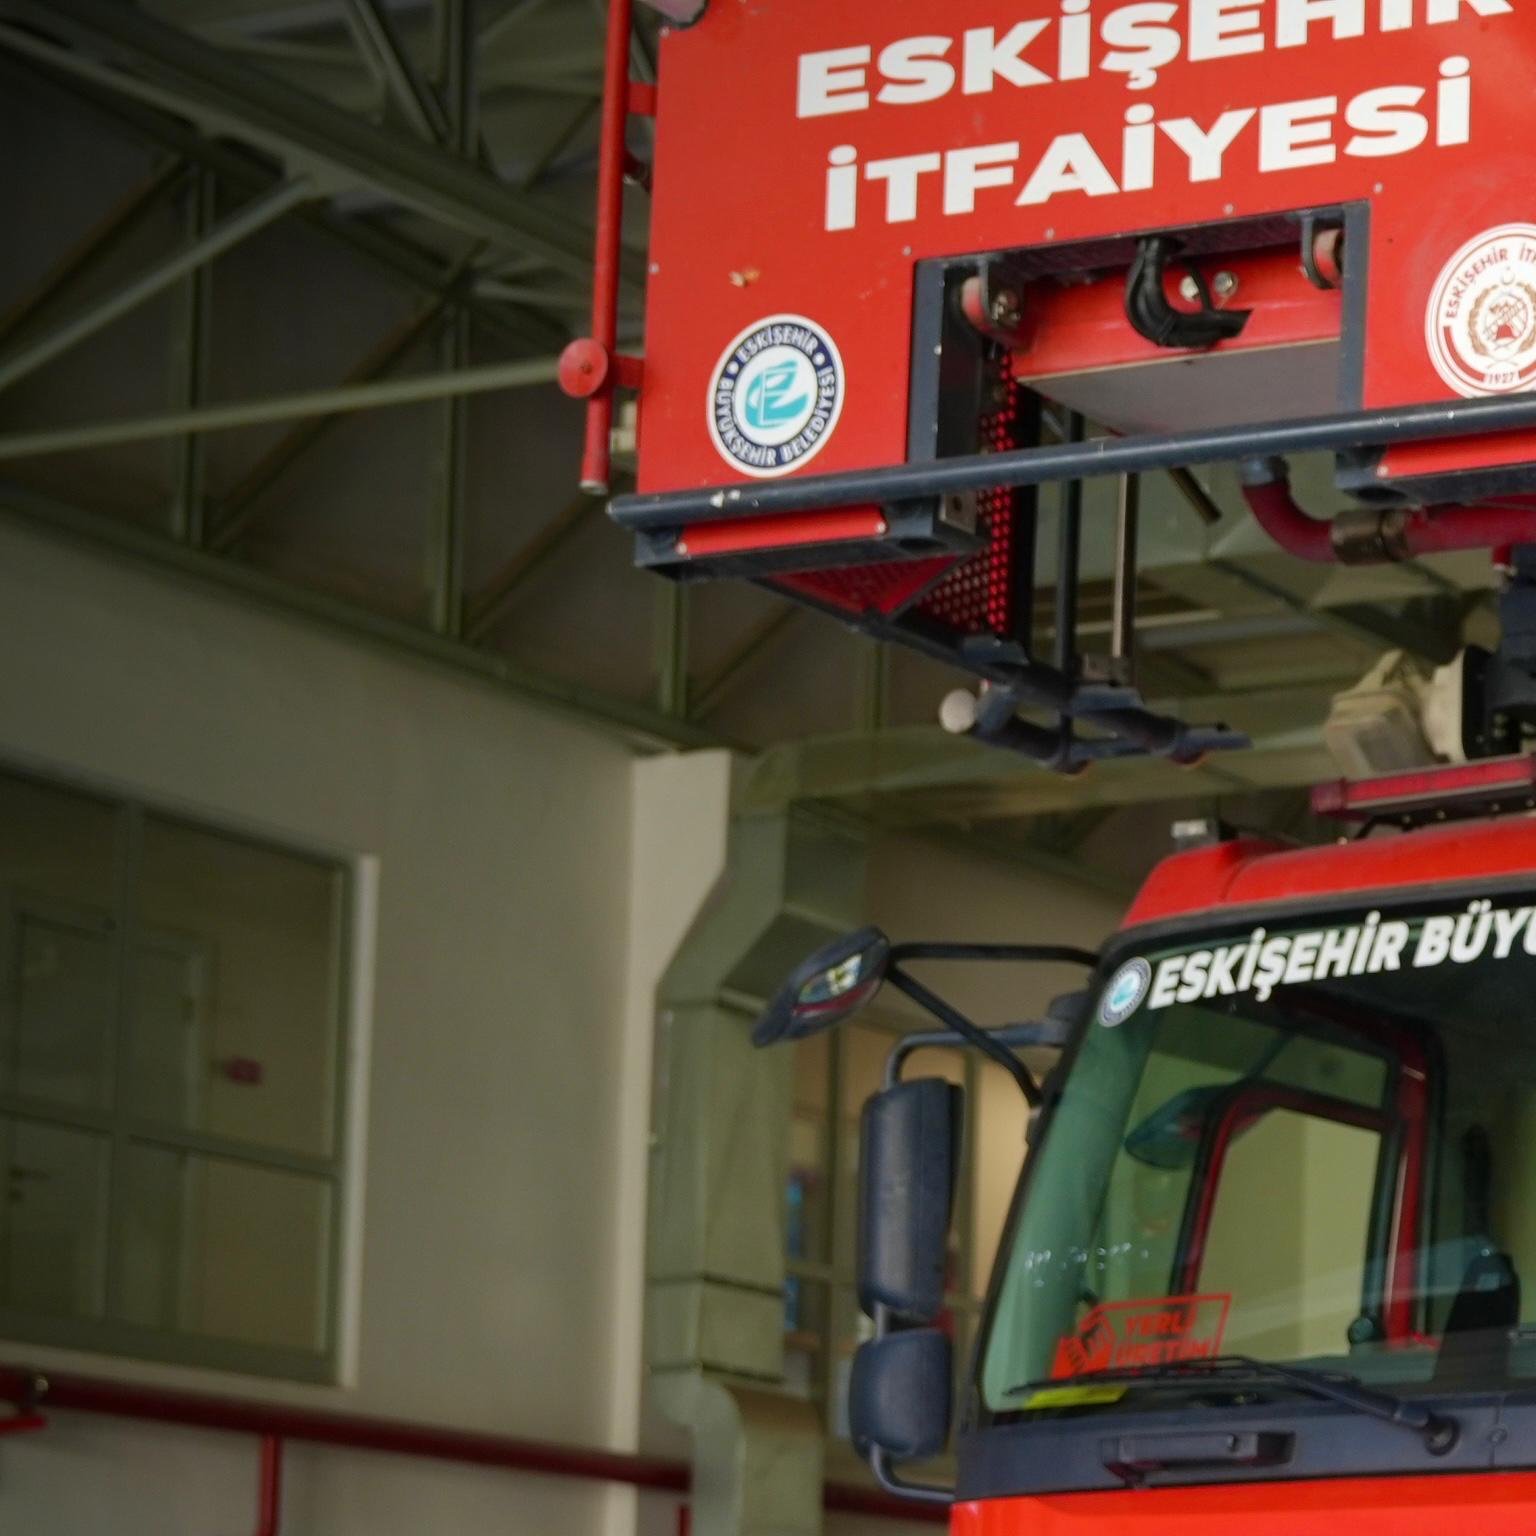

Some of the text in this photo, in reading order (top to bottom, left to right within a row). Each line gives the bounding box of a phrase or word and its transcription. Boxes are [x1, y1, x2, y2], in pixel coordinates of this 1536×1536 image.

[826, 56, 1471, 231] İTFAİYESİ
[1446, 246, 1509, 318] ESKİŞEHİR
[1148, 910, 1409, 1010] ESKİŞEHİR
